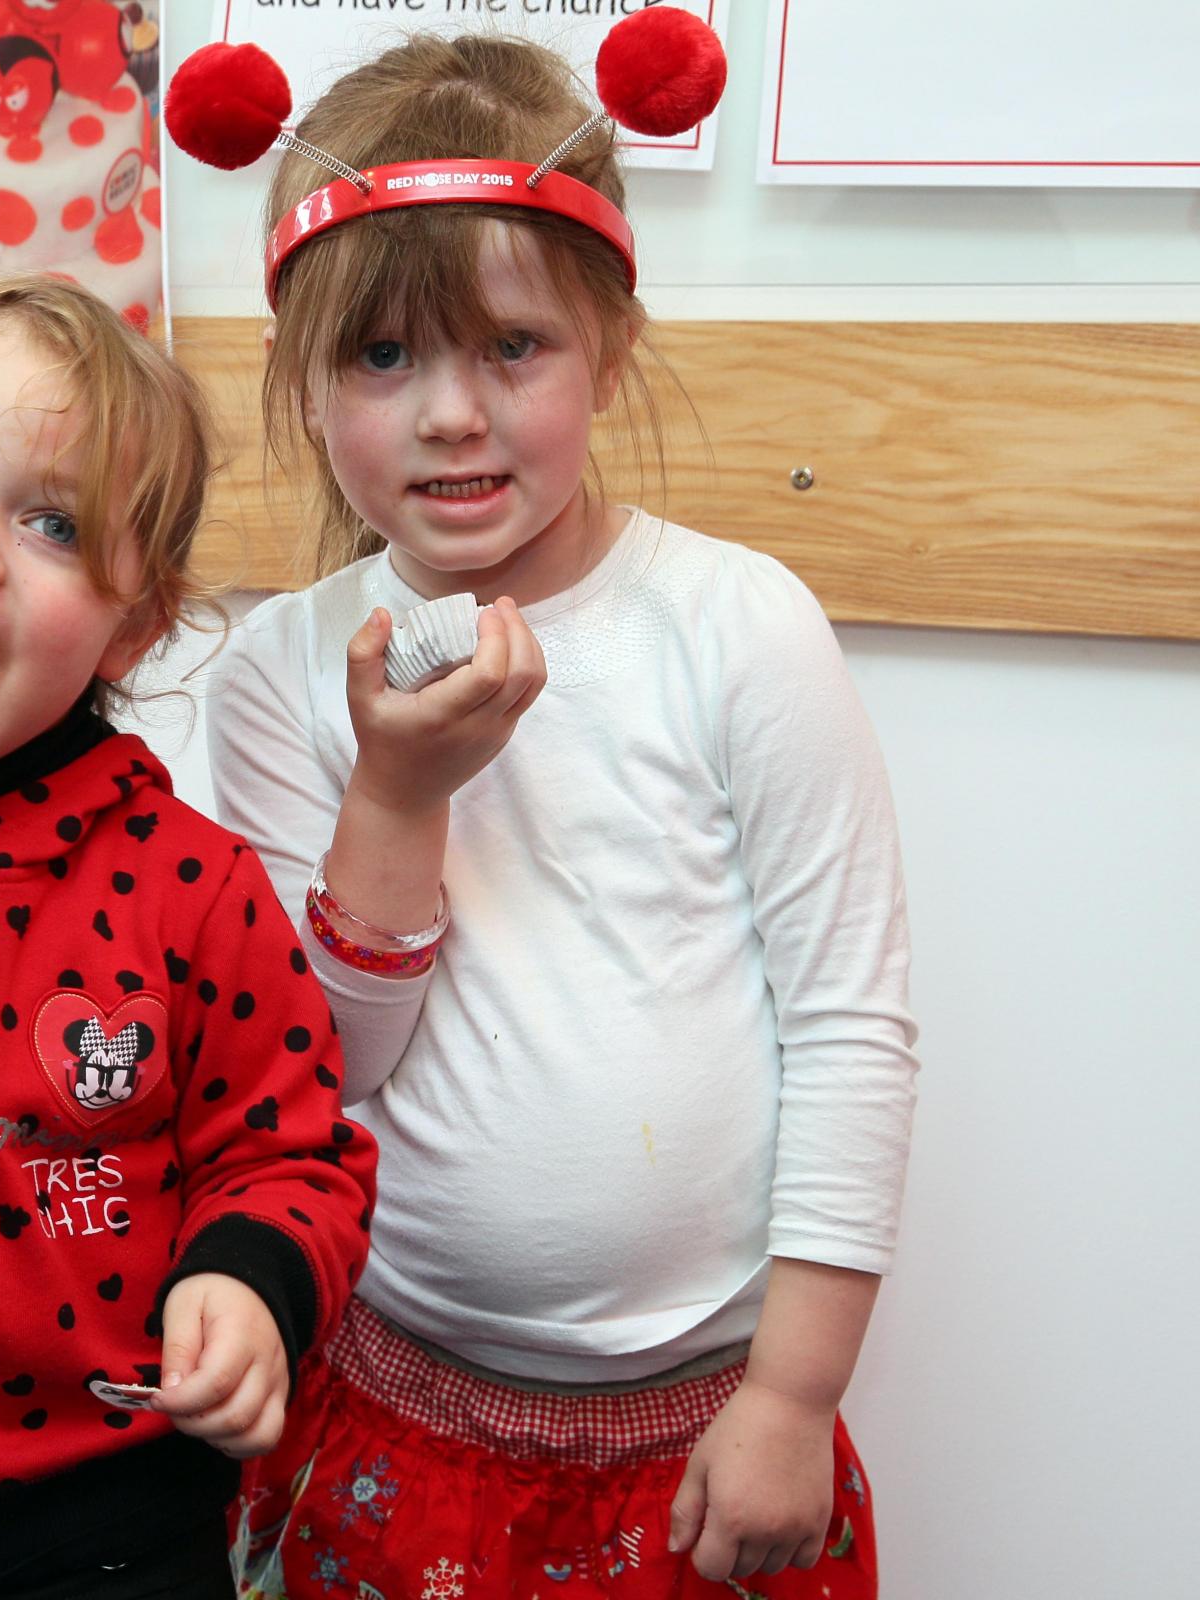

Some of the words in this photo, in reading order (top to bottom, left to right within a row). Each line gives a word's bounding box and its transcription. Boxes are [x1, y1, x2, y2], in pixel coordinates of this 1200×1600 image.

[387, 177, 413, 190] RED
[453, 173, 481, 185] DAY
[481, 174, 514, 187] 2015
[21, 1155, 123, 1196] TRES
